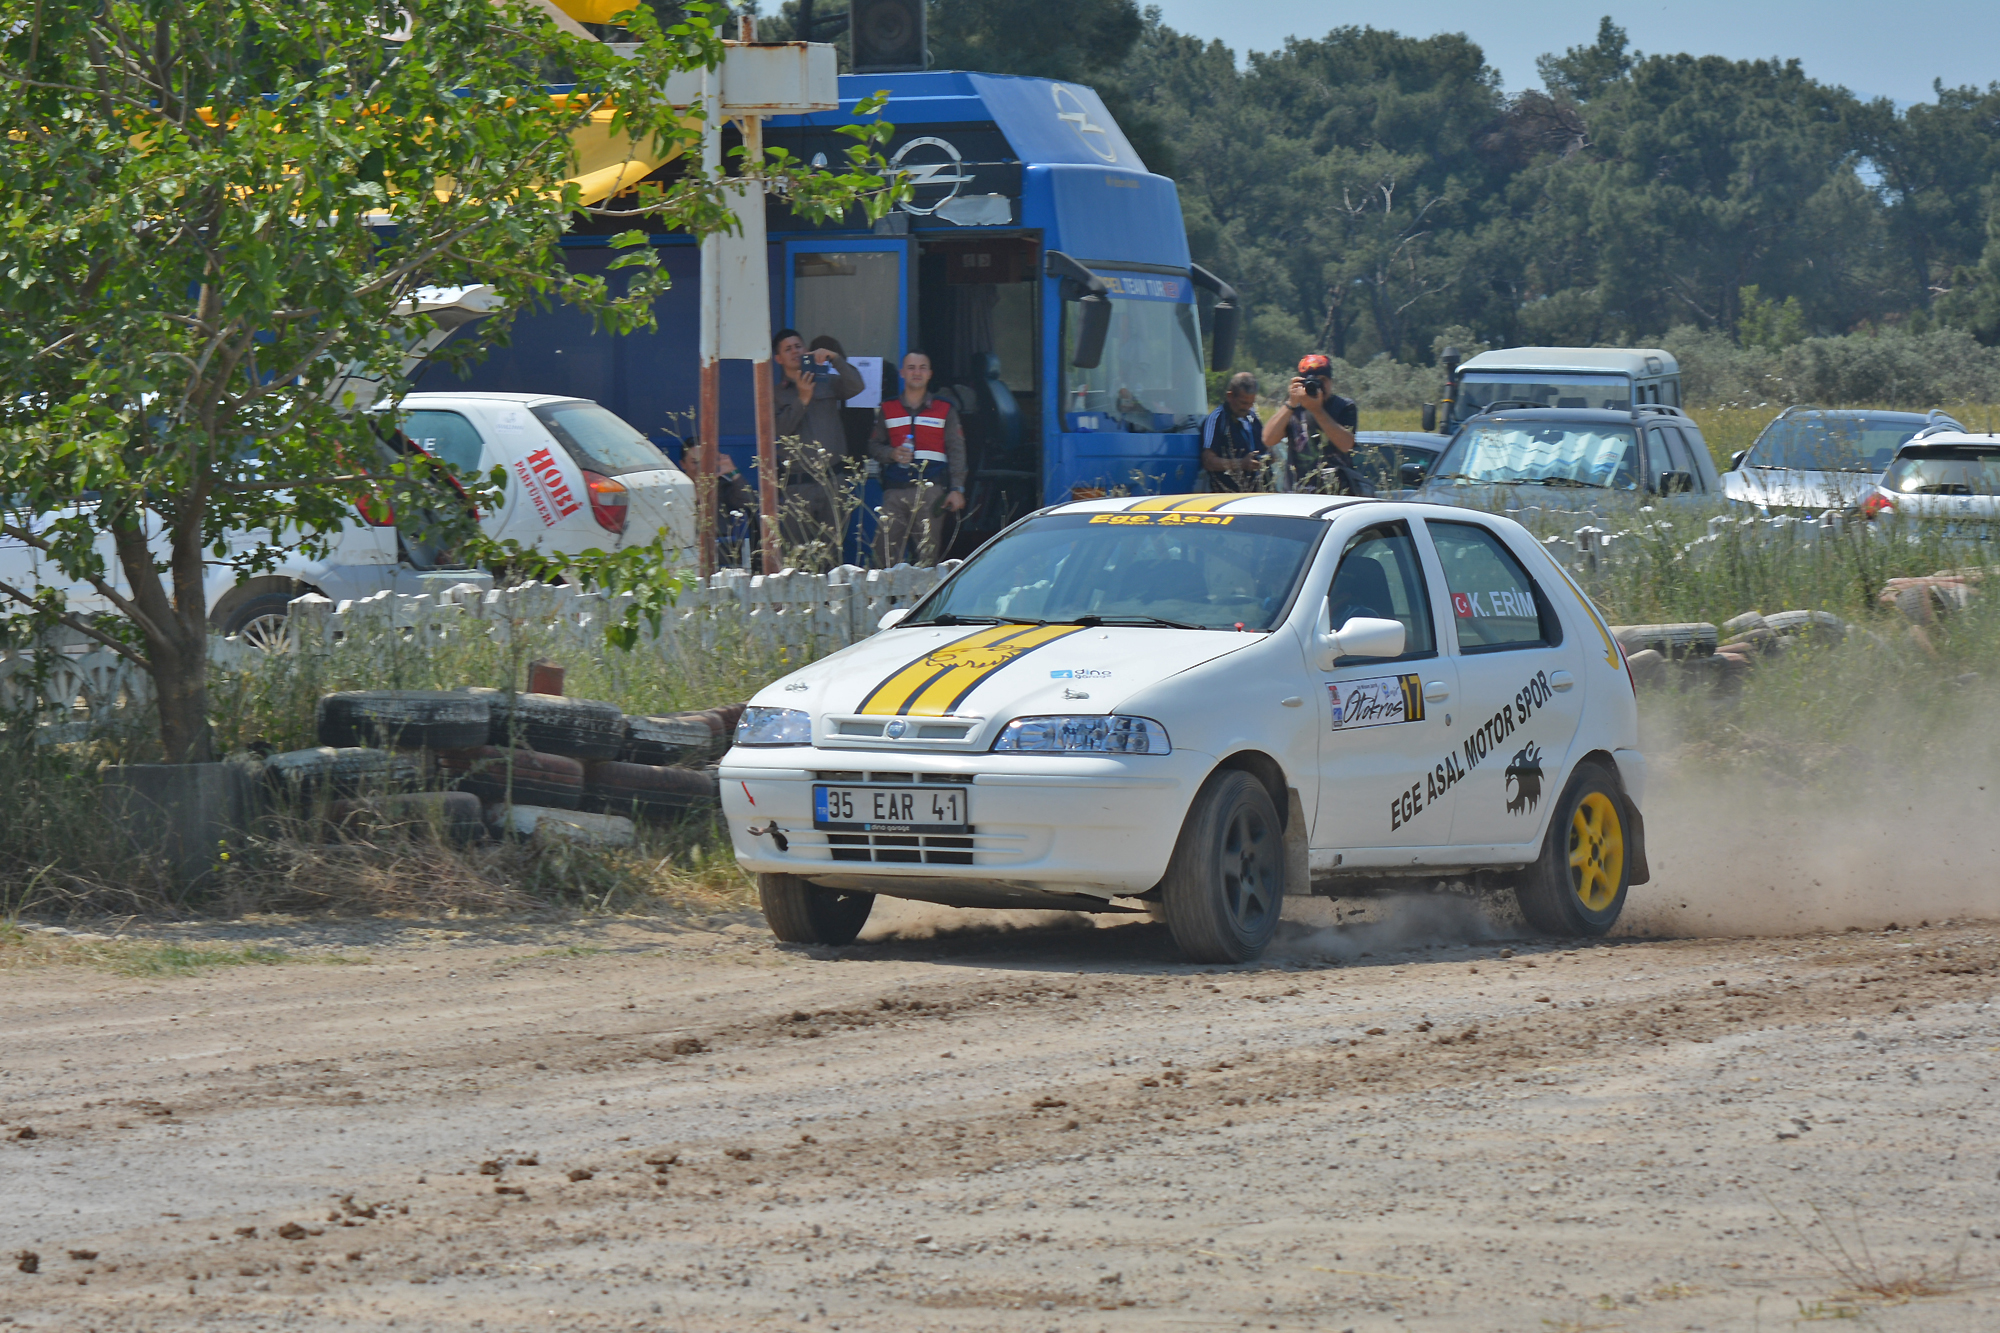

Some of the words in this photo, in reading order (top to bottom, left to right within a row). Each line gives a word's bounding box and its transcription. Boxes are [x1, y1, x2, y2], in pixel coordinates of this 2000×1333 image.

[526, 447, 583, 517] HOBİ
[1089, 514, 1150, 525] Ege
[1157, 513, 1234, 525] Asal
[1467, 592, 1490, 617] K.
[1489, 587, 1538, 617] ERİM
[1400, 675, 1421, 720] 17
[1391, 782, 1423, 832] EGE
[1427, 751, 1465, 806] ASAL
[1463, 704, 1515, 771] MOTOR
[1515, 670, 1552, 725] SPOR
[829, 791, 854, 818] 35
[873, 792, 914, 820] EAR
[932, 794, 957, 821] 41
